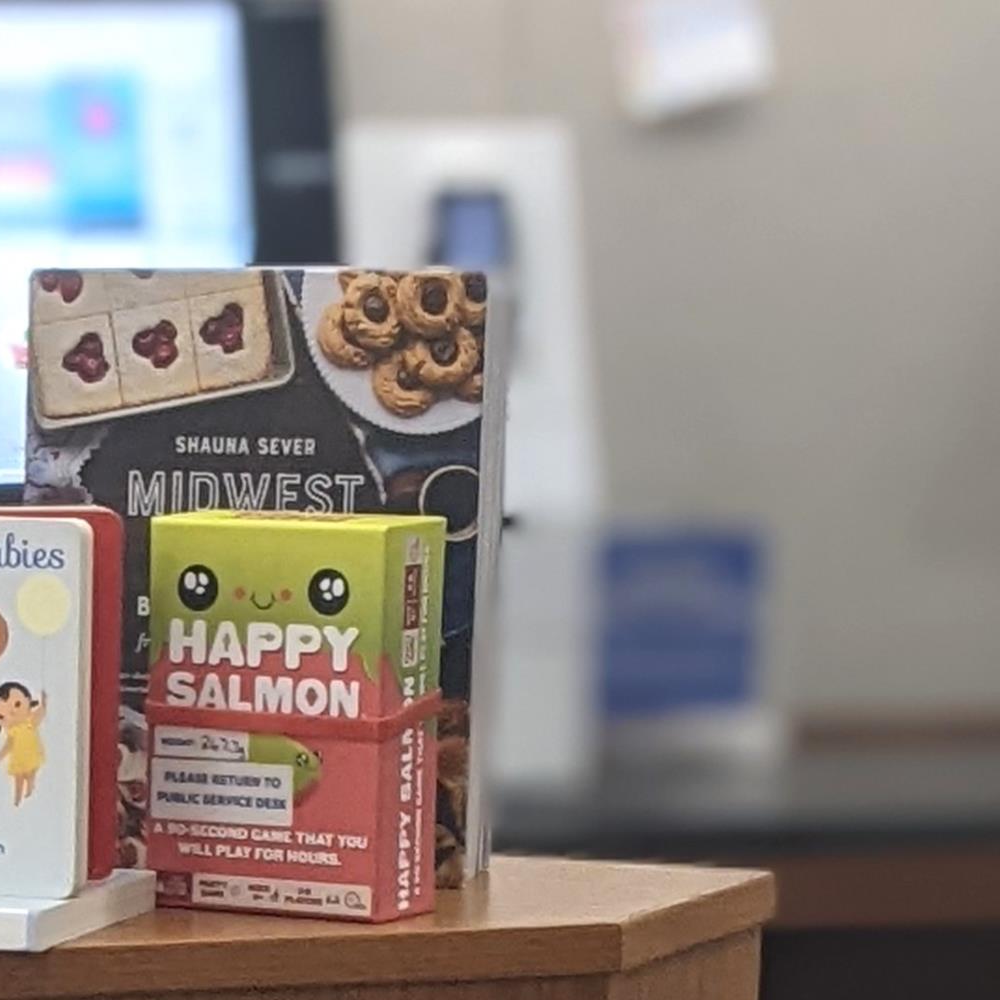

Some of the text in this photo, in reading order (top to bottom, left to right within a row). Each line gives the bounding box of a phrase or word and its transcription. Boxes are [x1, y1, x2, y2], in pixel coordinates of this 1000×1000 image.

[175, 435, 316, 456] SHAUNA SEVER
[126, 468, 365, 516] MIDWEST
[167, 618, 360, 673] HAPPY
[165, 671, 361, 719] SALMON
[399, 676, 416, 800] SALMN
[163, 771, 283, 790] PLEASE RETURN TO
[156, 791, 288, 811] PUBLIC SERVICE DESK
[153, 823, 164, 835] A
[251, 828, 293, 843] GAME
[296, 831, 334, 848] THAT
[338, 833, 369, 850] YOU
[178, 842, 213, 857] WILL
[215, 844, 253, 859] PLAY
[254, 847, 285, 862] FOR
[397, 811, 414, 911] HAPPY
